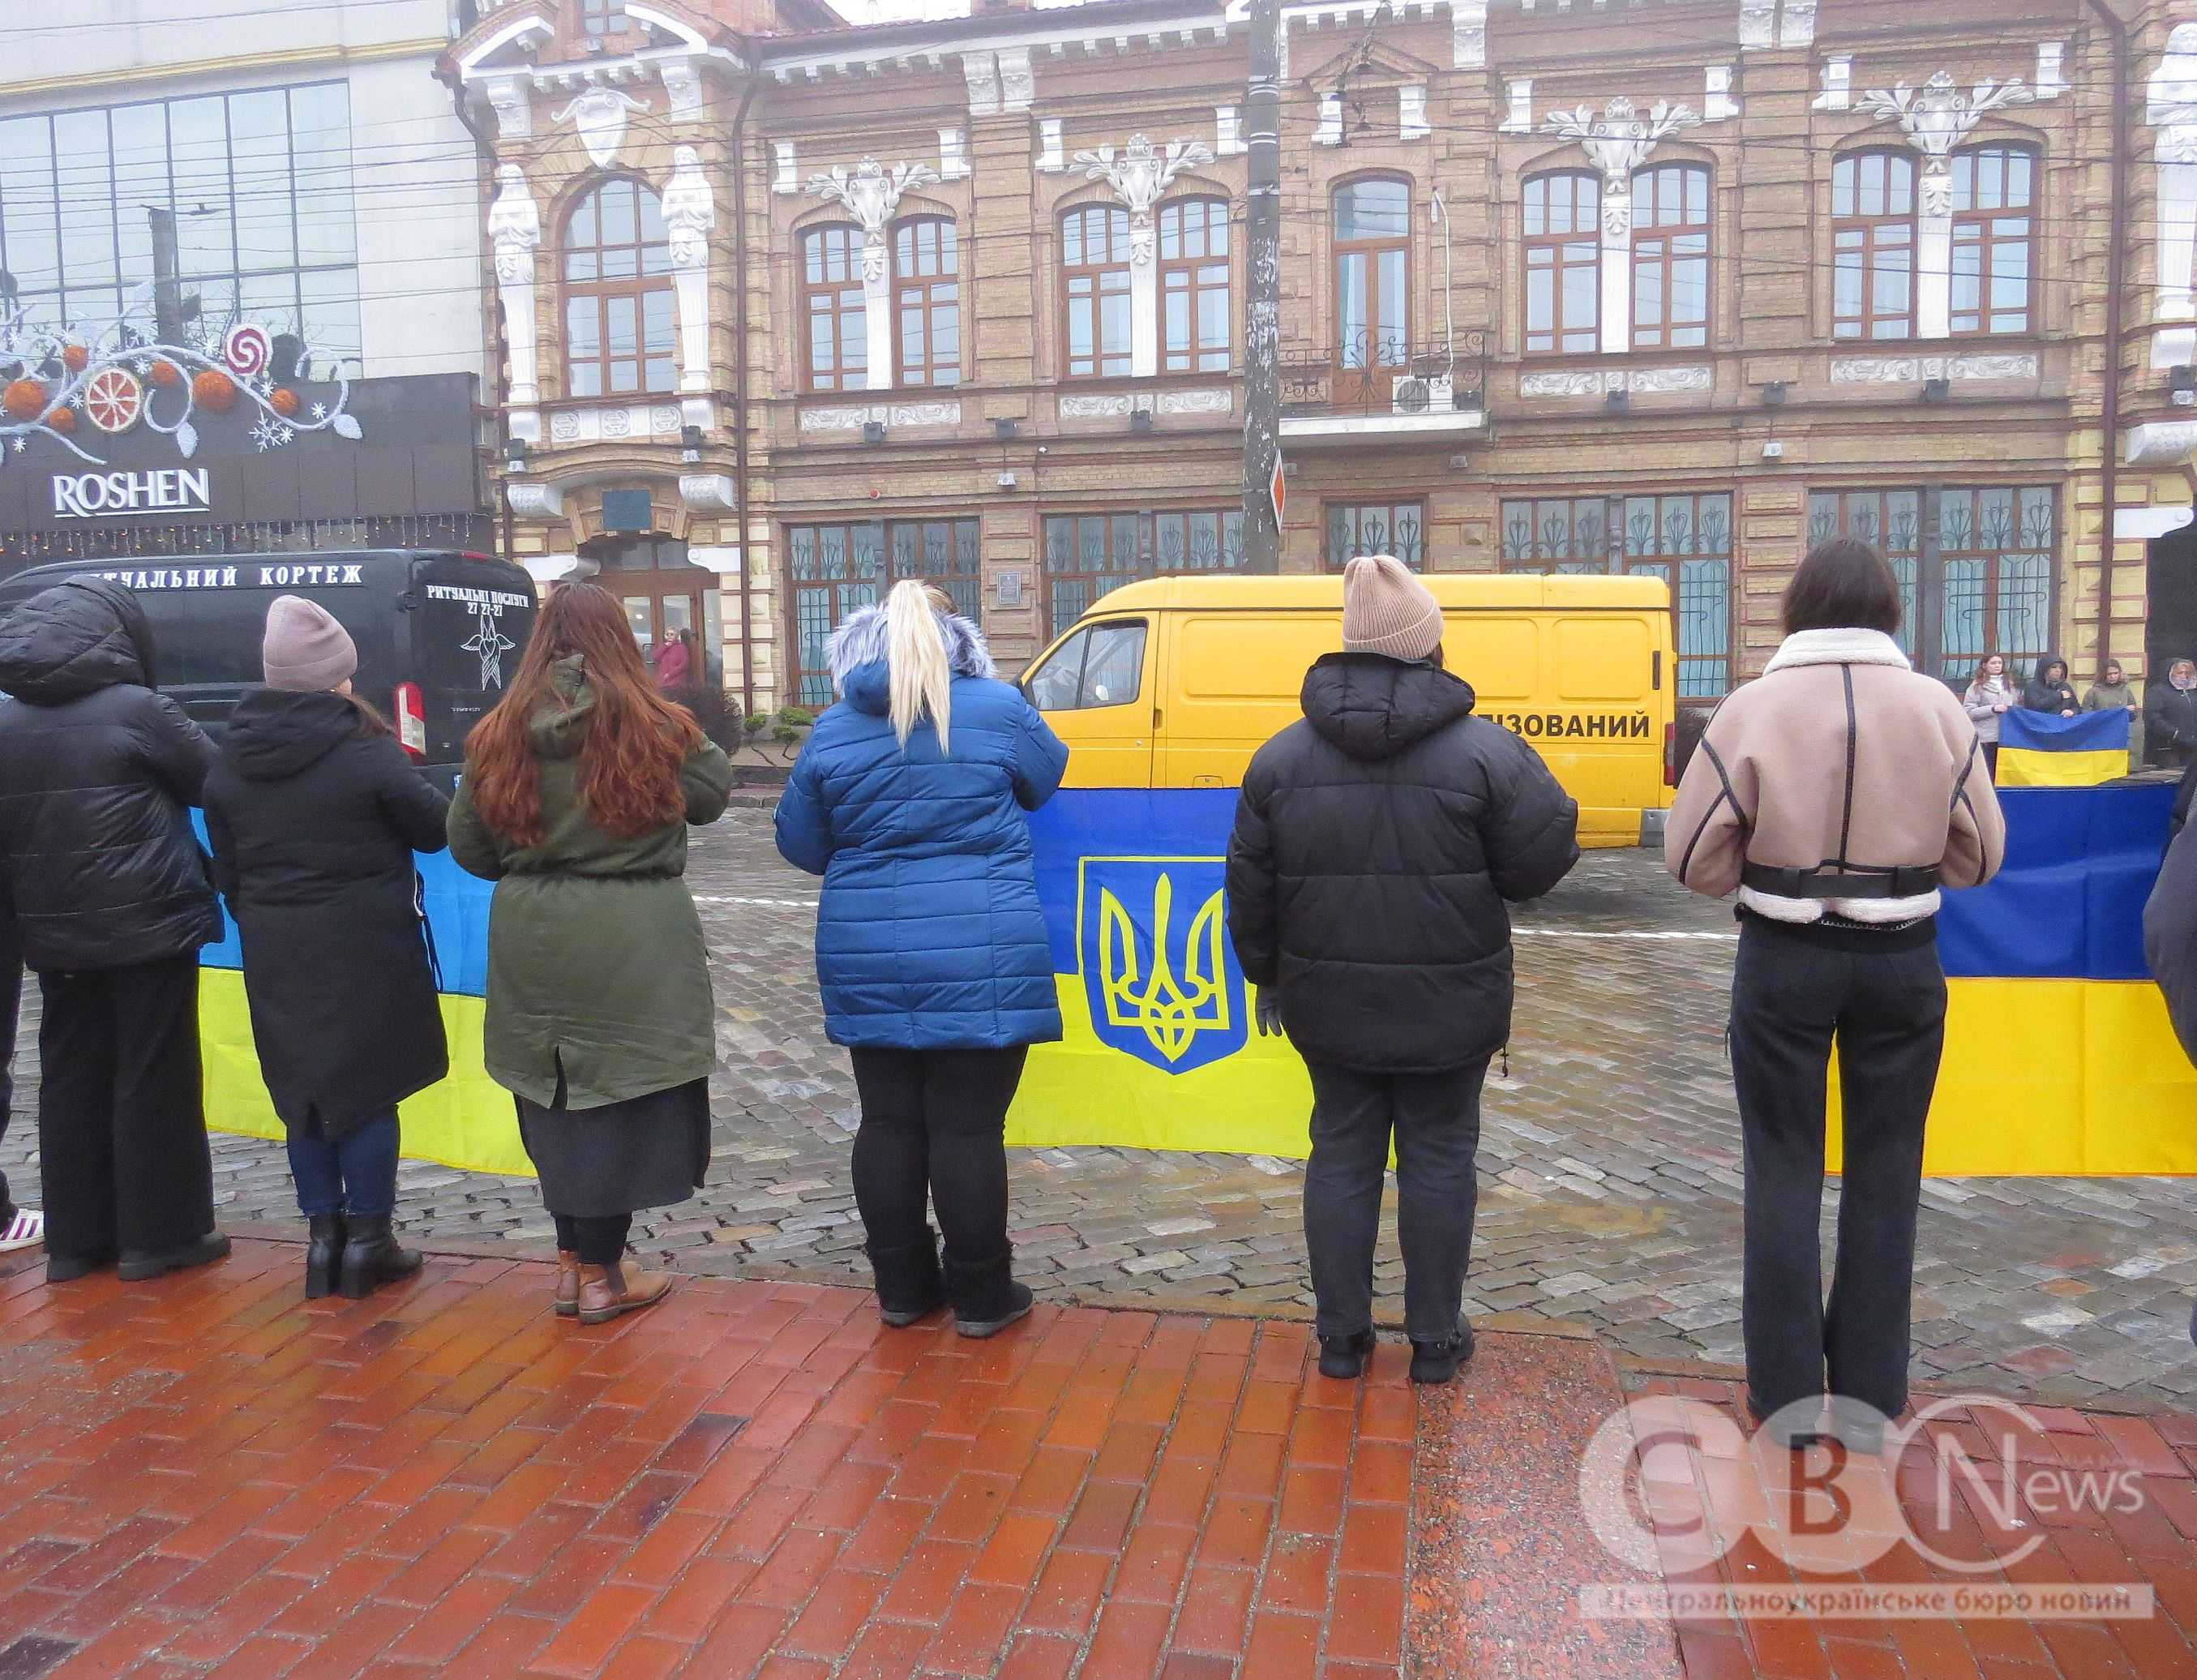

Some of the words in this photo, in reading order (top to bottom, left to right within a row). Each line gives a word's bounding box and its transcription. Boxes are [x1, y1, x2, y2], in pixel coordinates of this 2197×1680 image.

[53, 468, 210, 517] ROSHEN
[259, 564, 363, 586] КОРТЕЖ
[426, 585, 489, 603] РИТУАЛЬНІ
[490, 590, 529, 607] ПОСЛУГИ
[468, 602, 478, 615] 27
